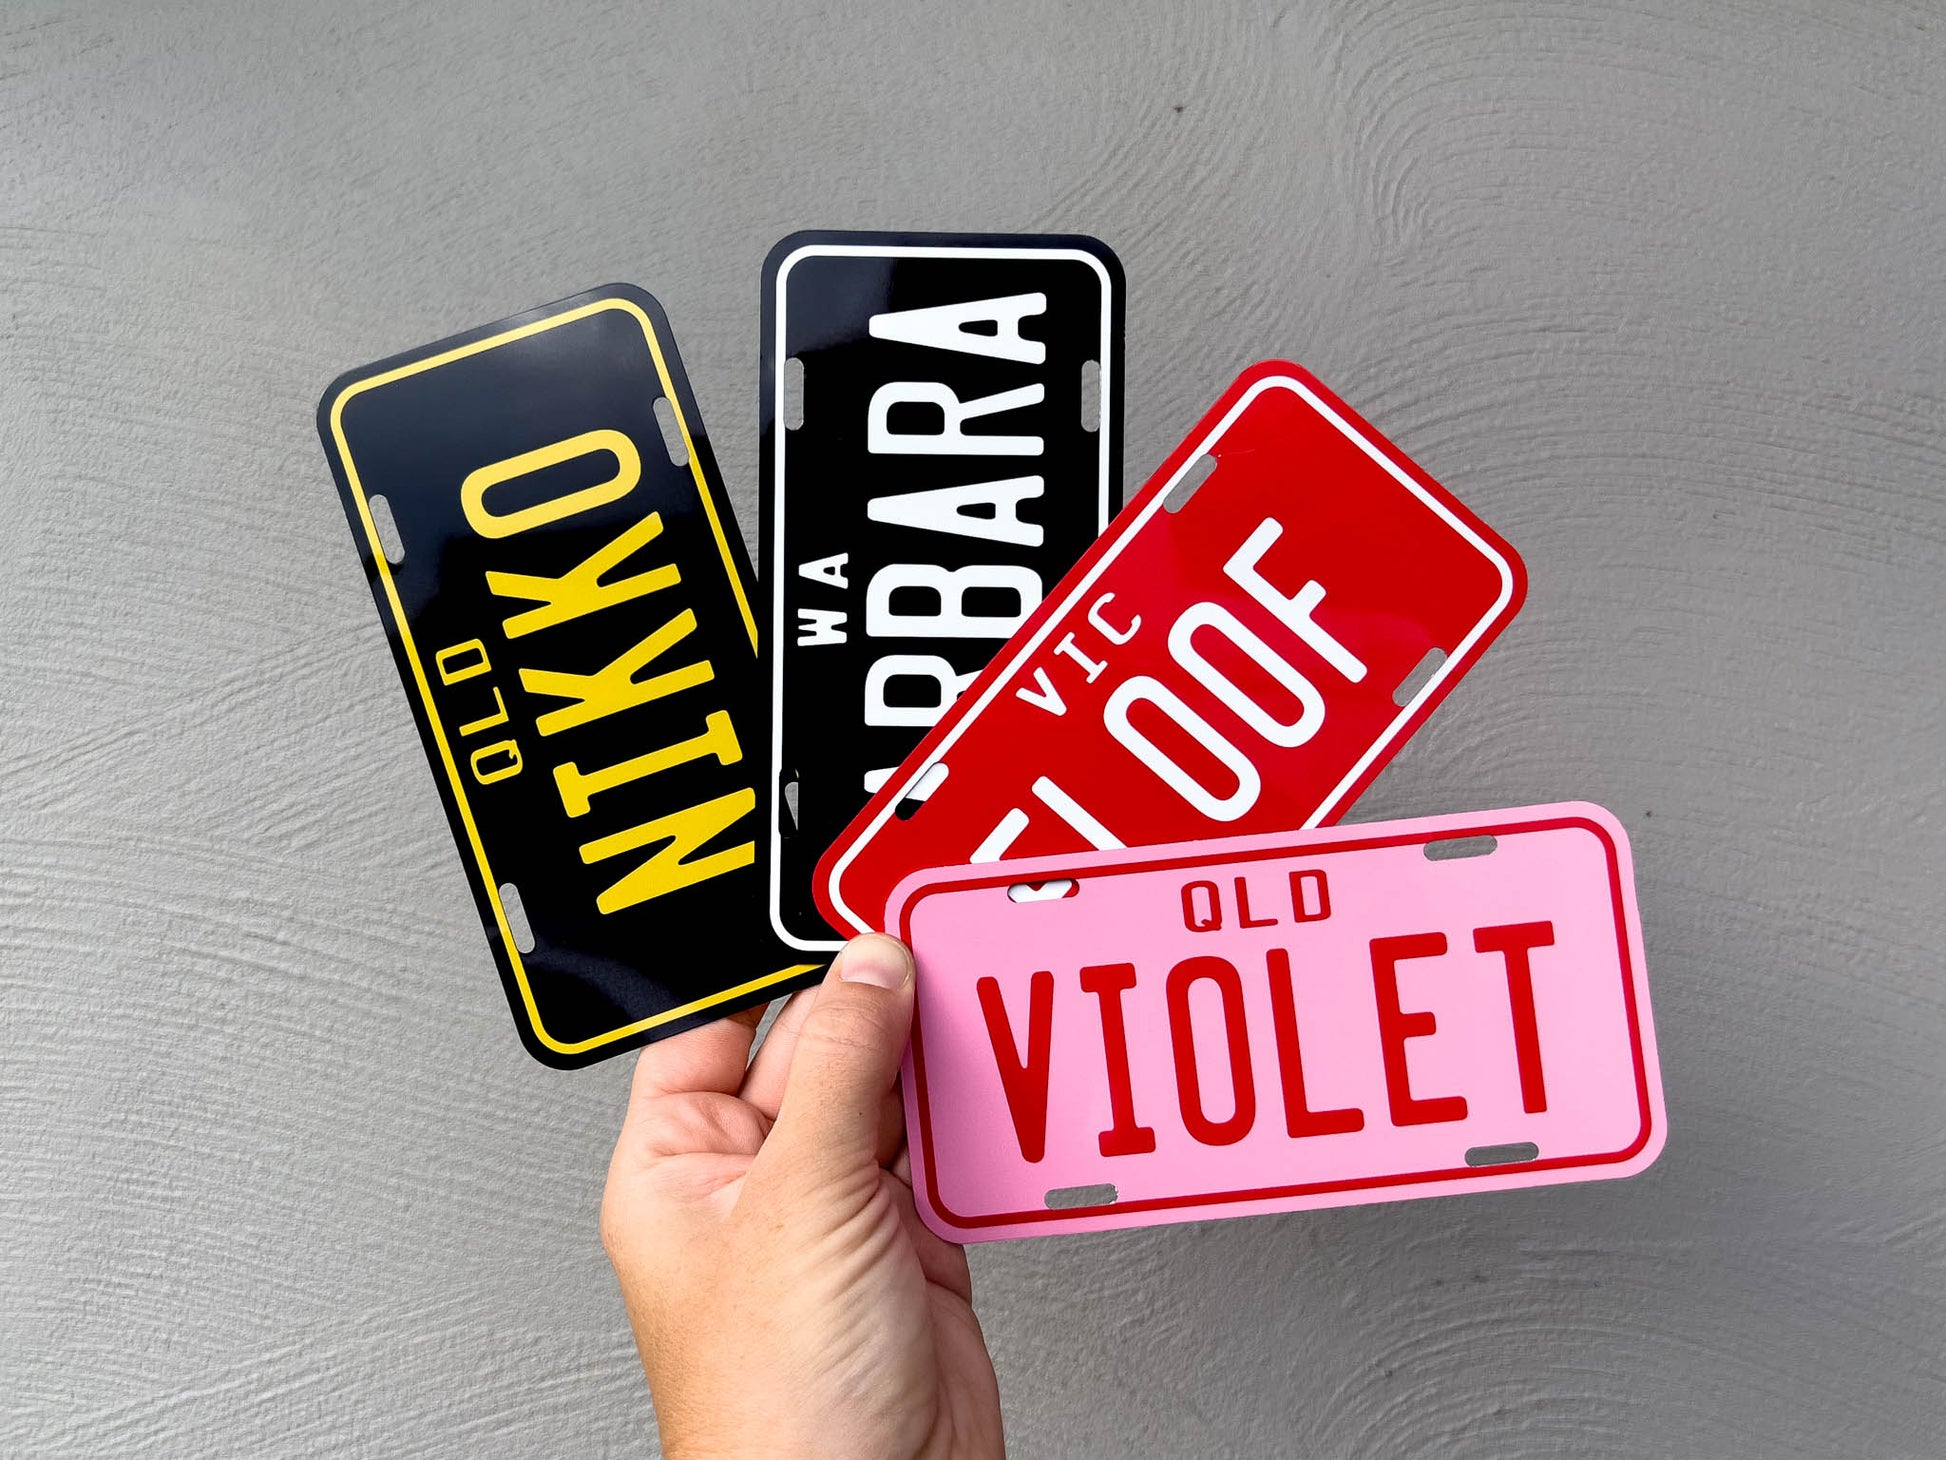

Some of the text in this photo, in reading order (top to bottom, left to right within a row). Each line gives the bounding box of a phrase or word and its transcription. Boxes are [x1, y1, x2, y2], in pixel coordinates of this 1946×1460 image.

[797, 552, 849, 646] WA
[863, 292, 1047, 794] RBARA
[435, 638, 524, 786] QLD
[461, 429, 756, 915] NIKKO
[1015, 592, 1142, 717] VIC
[1180, 869, 1332, 933] QLD
[976, 920, 1555, 1164] VIOLET
